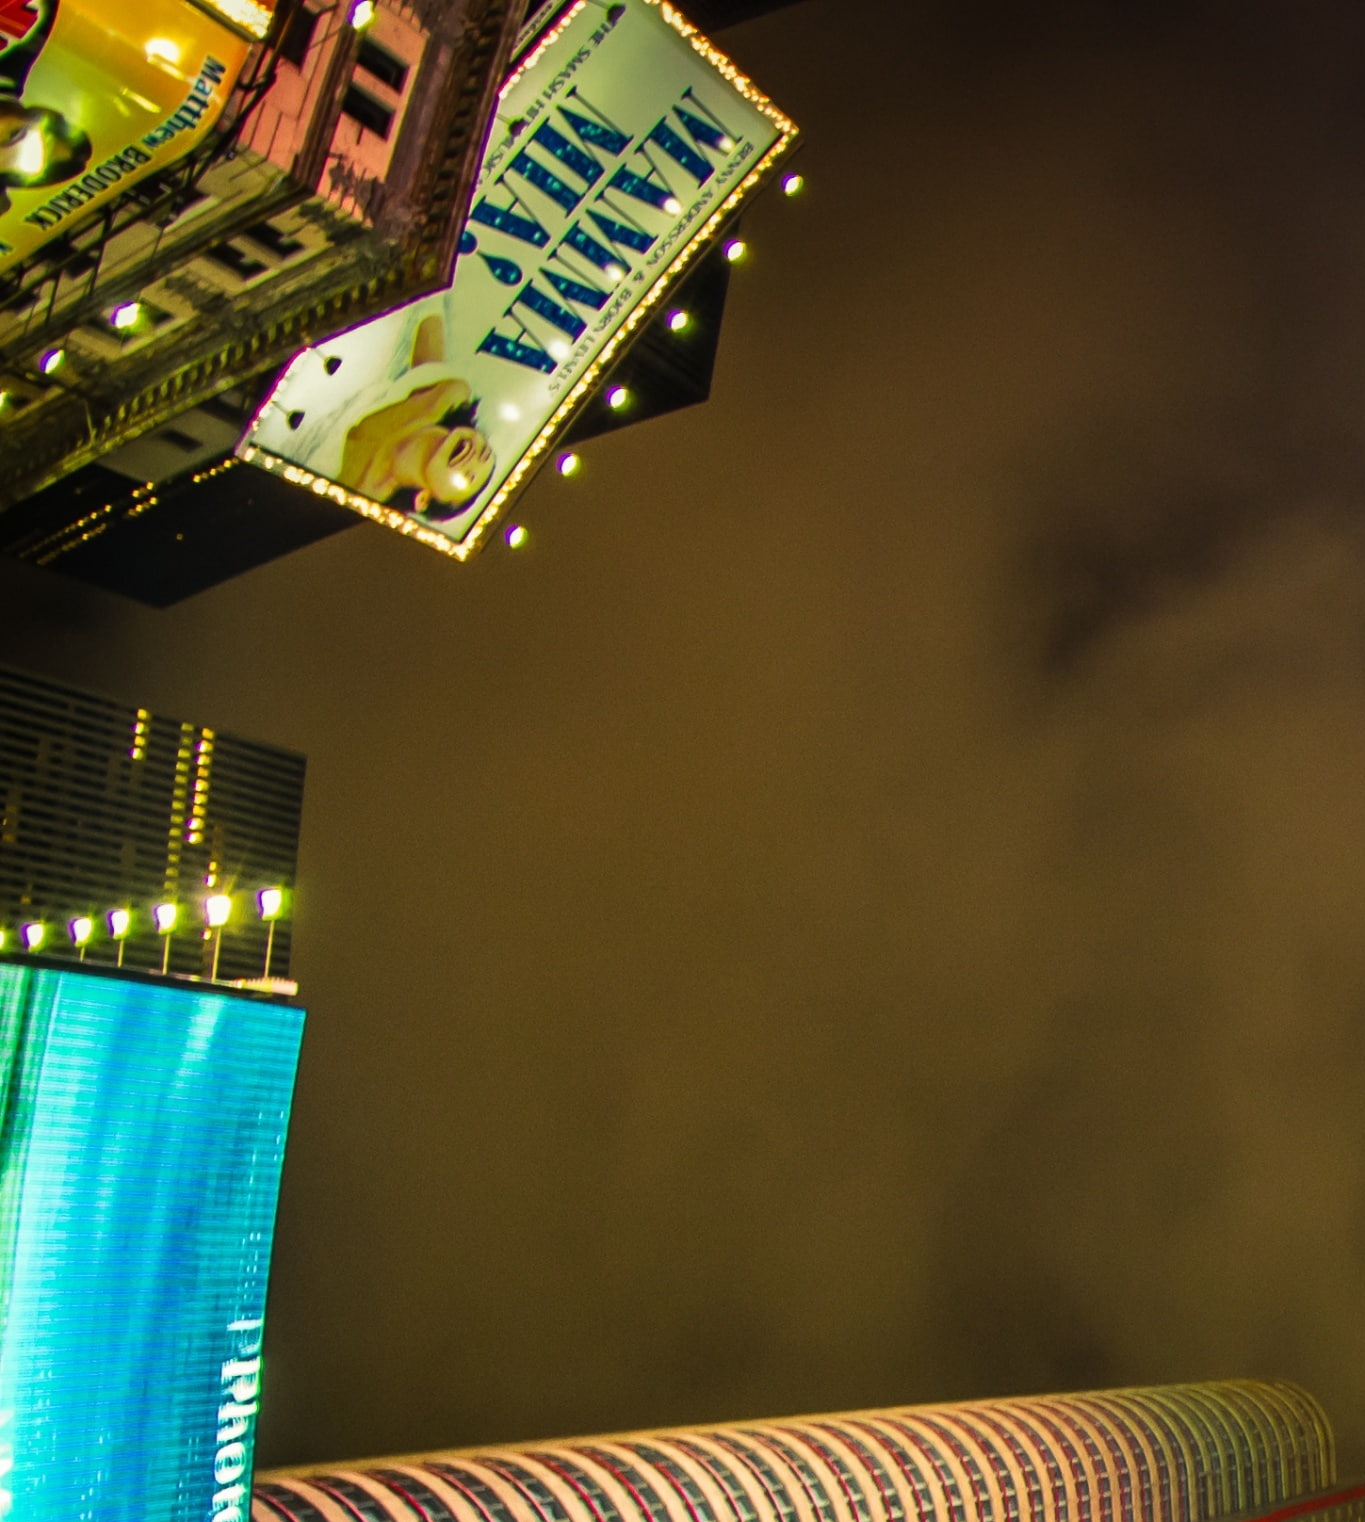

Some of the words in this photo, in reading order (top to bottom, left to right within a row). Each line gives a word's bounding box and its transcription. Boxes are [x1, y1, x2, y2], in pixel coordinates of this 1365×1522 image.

[142, 56, 226, 149] Matthew
[518, 97, 547, 129] HIT
[541, 44, 593, 102] SMASH
[24, 144, 150, 230] BRODERICK
[460, 85, 635, 287] MIA!
[715, 140, 755, 188] BENNY
[478, 86, 743, 376] MAMMA
[645, 187, 717, 269] ANDERSSON
[633, 270, 647, 283] &
